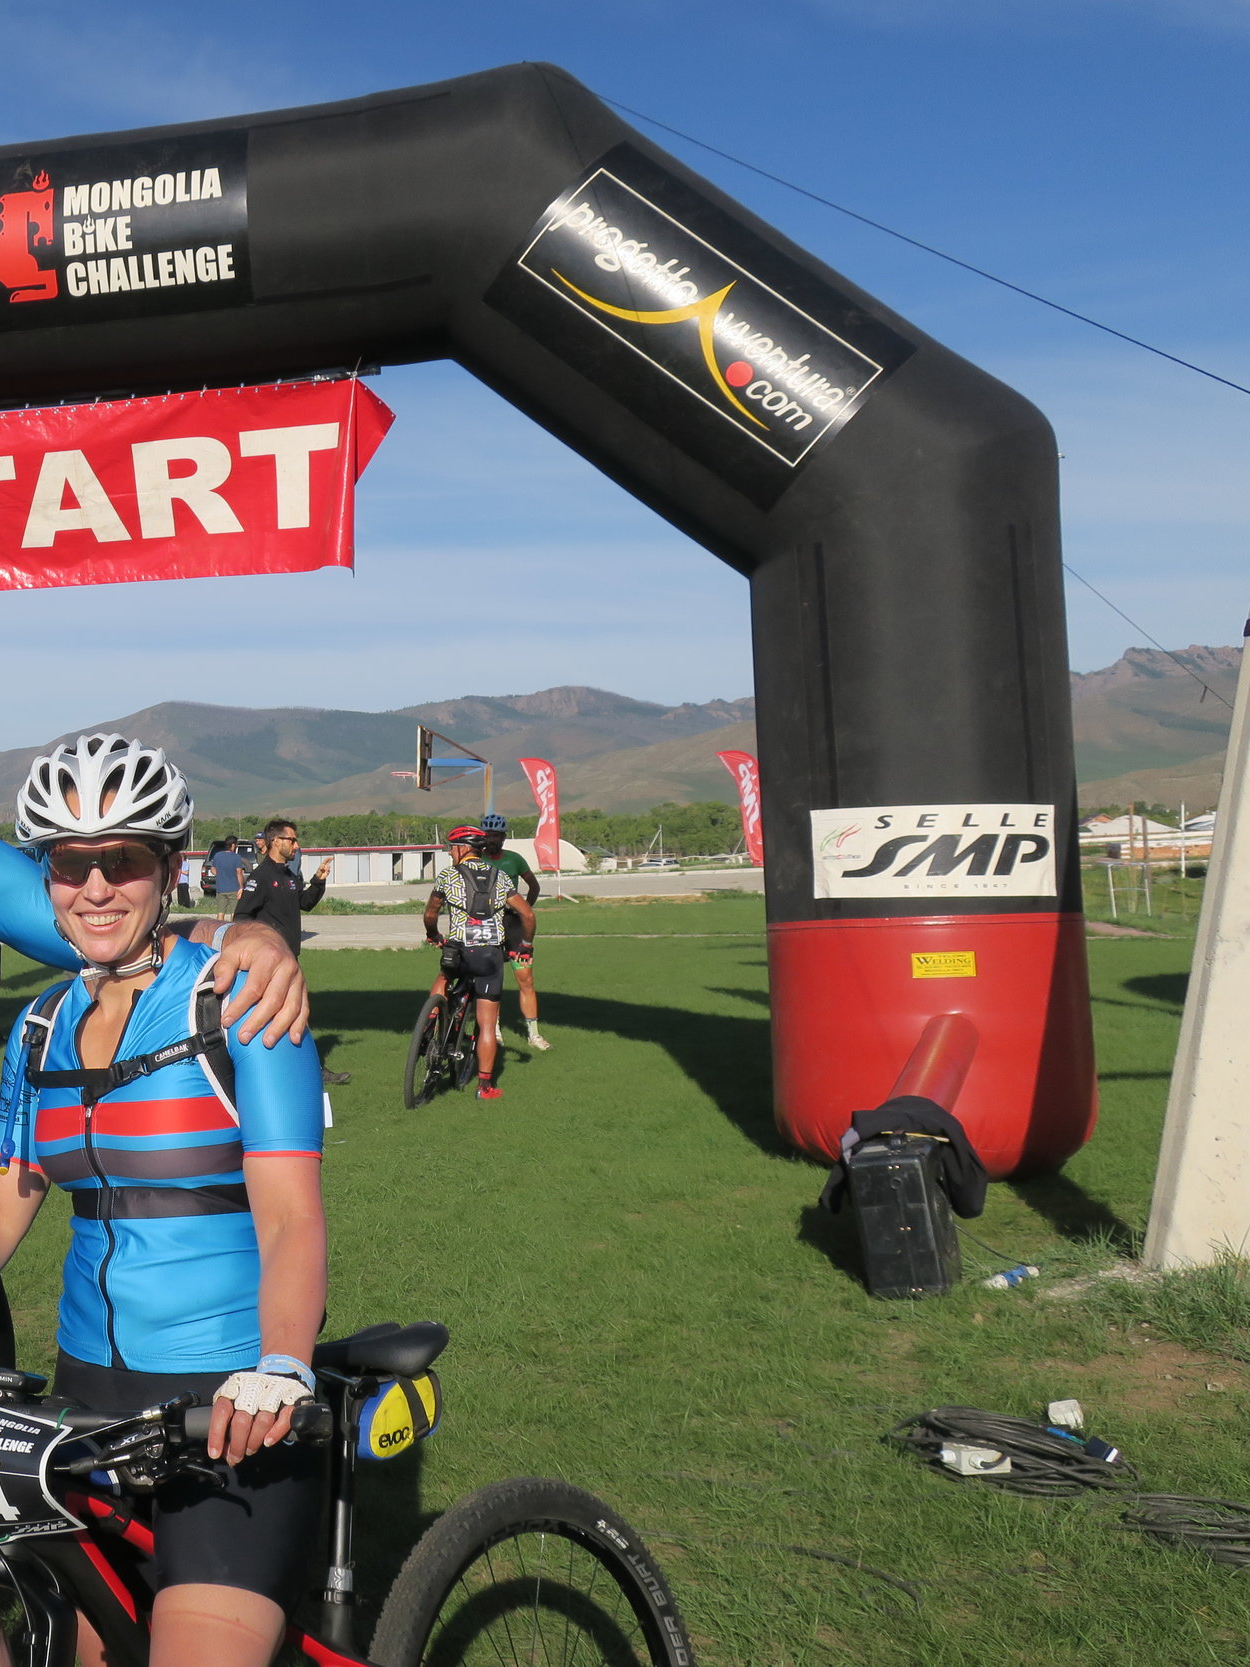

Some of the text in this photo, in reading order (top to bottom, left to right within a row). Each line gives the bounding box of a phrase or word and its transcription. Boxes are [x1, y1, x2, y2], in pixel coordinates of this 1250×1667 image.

[63, 167, 223, 217] MONGOLIA
[548, 202, 700, 305] progetto
[66, 244, 236, 298] CHALLENGE
[873, 812, 1049, 830] SELLE
[840, 833, 1051, 878] SMP
[472, 928, 492, 940] 25
[915, 956, 972, 965] WELDING
[154, 1043, 189, 1063] CAMELBAK
[378, 1426, 410, 1449] evoc
[627, 1554, 668, 1607] BURT
